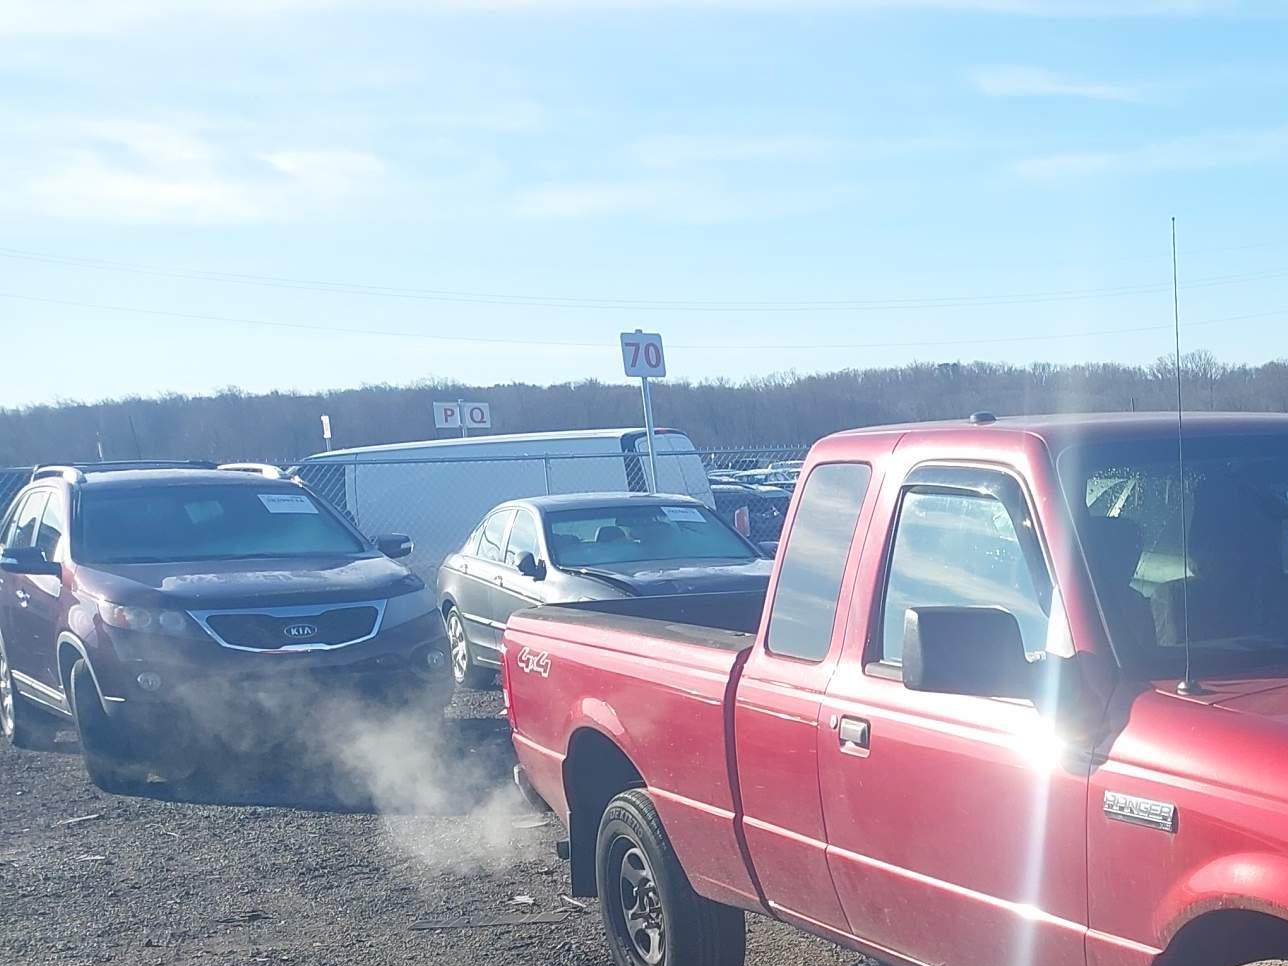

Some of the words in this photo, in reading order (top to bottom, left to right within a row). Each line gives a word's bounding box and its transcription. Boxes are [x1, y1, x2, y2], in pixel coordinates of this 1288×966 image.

[624, 342, 661, 369] 70
[444, 407, 455, 423] P
[470, 407, 487, 424] Q
[291, 626, 312, 635] KIA
[517, 646, 551, 678] 4x4
[1105, 793, 1172, 821] RANGER
